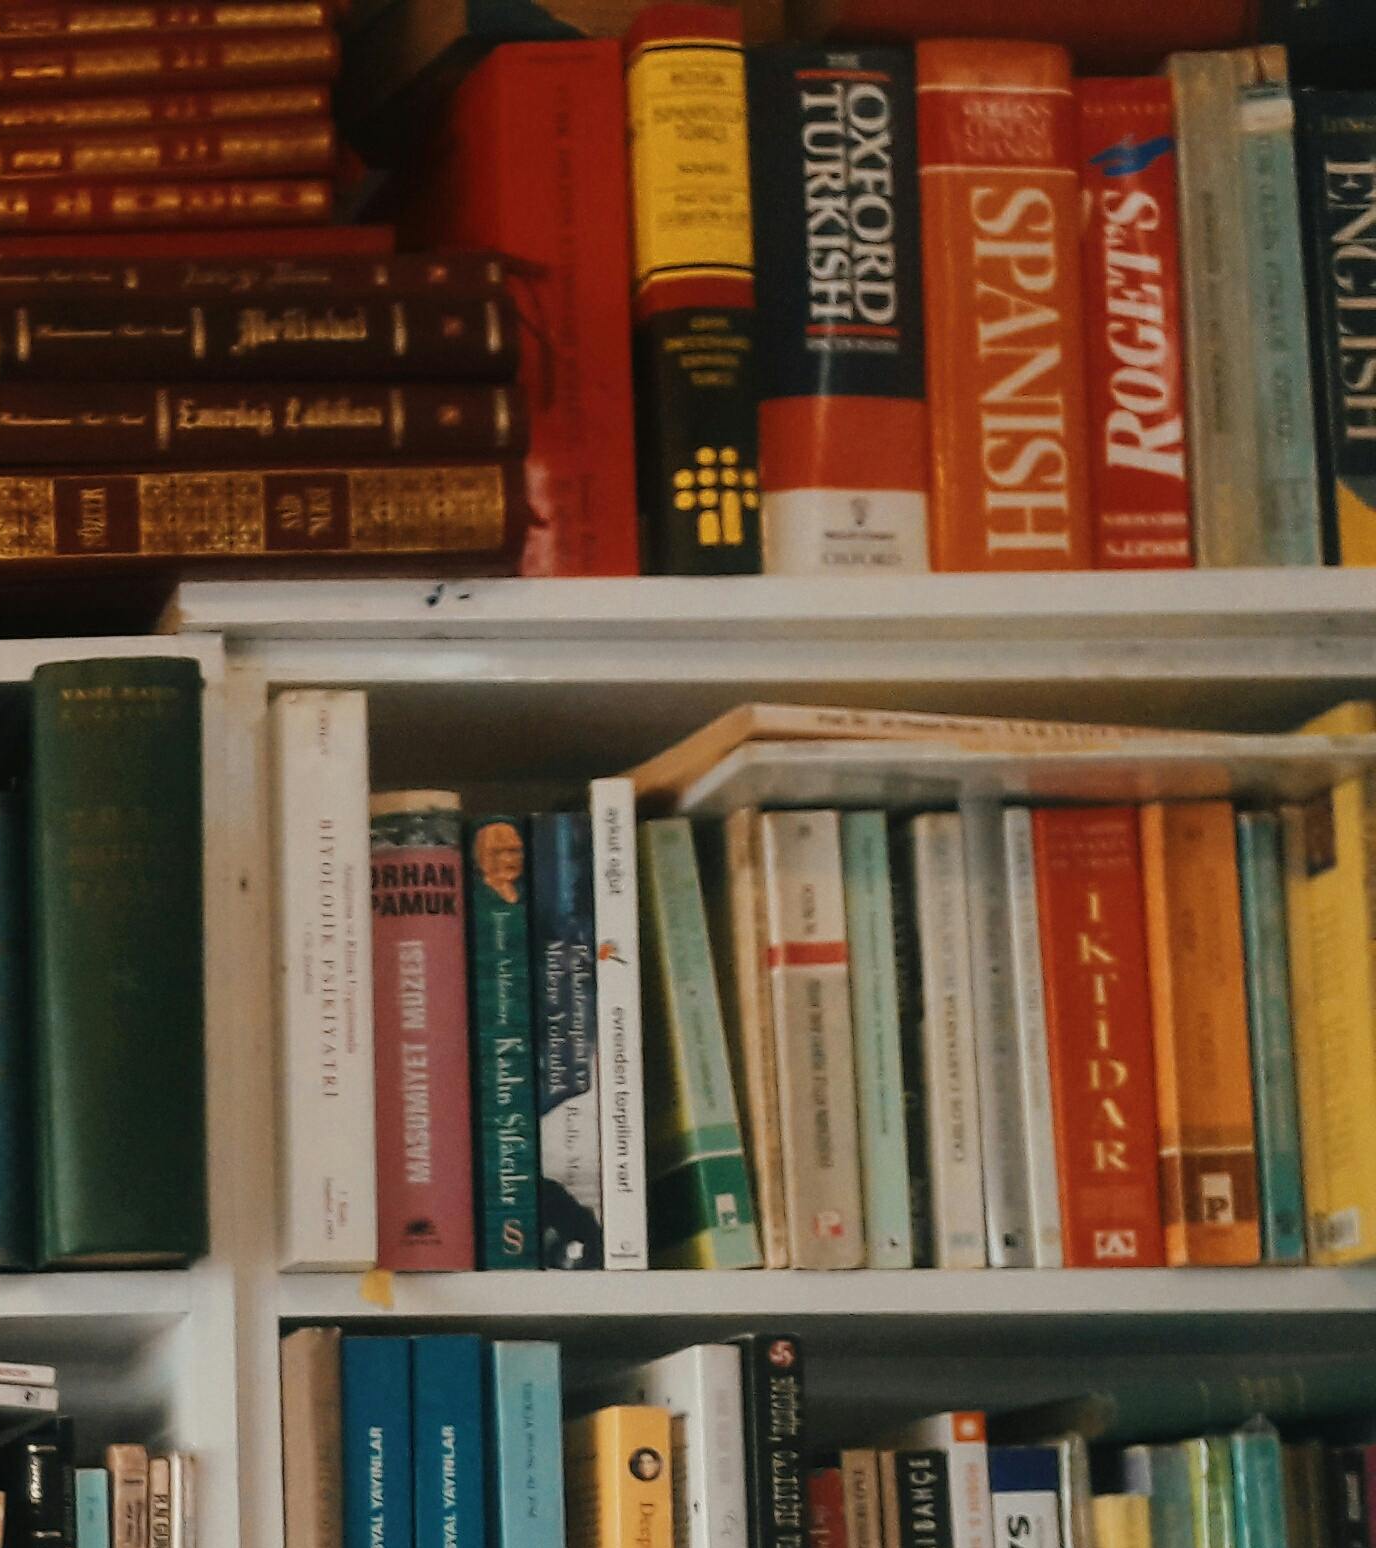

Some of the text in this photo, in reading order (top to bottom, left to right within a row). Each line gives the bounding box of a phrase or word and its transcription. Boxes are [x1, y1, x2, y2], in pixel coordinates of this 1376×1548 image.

[801, 84, 854, 321] TURKISH
[847, 83, 899, 326] OXFORD
[970, 187, 1070, 554] SPANISH
[368, 1426, 385, 1509] YAYINLAR
[440, 1425, 457, 1508] YAYINLAR
